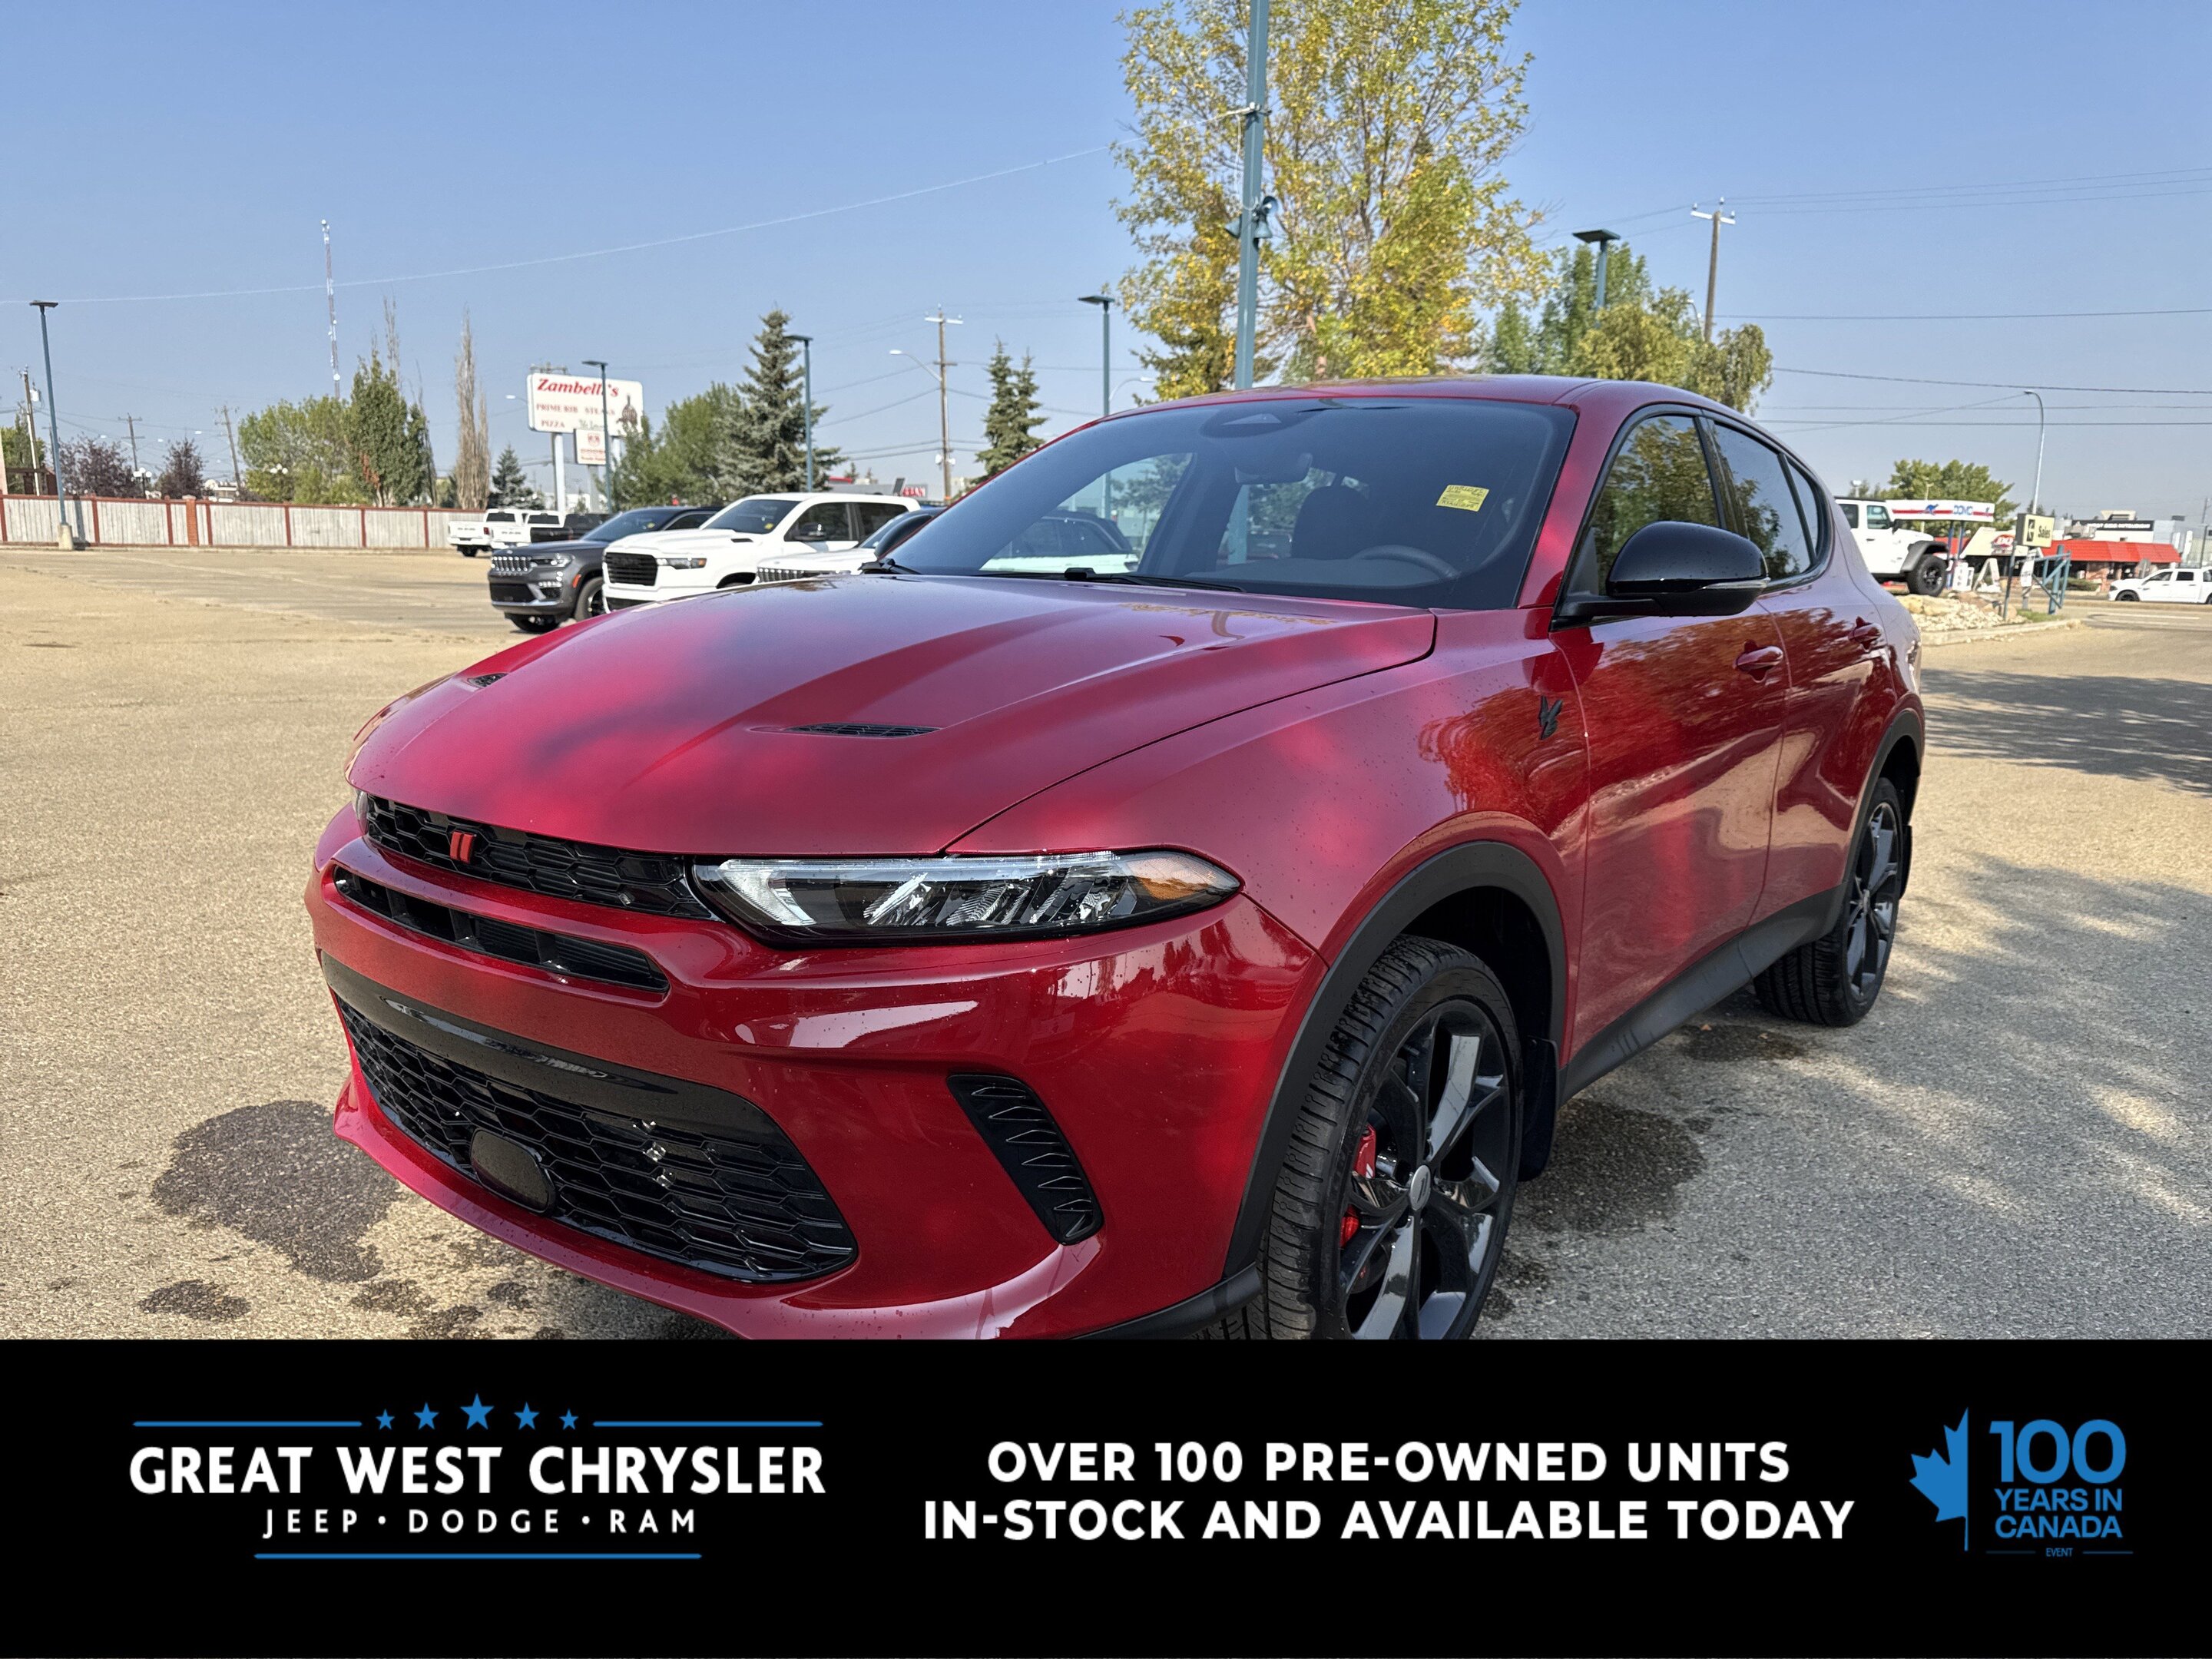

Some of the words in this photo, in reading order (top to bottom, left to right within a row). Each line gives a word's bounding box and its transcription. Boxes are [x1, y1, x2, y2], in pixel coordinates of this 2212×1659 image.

[537, 379, 619, 397] Zambell's
[541, 420, 565, 429] PIZZA
[2038, 525, 2051, 538] Sales
